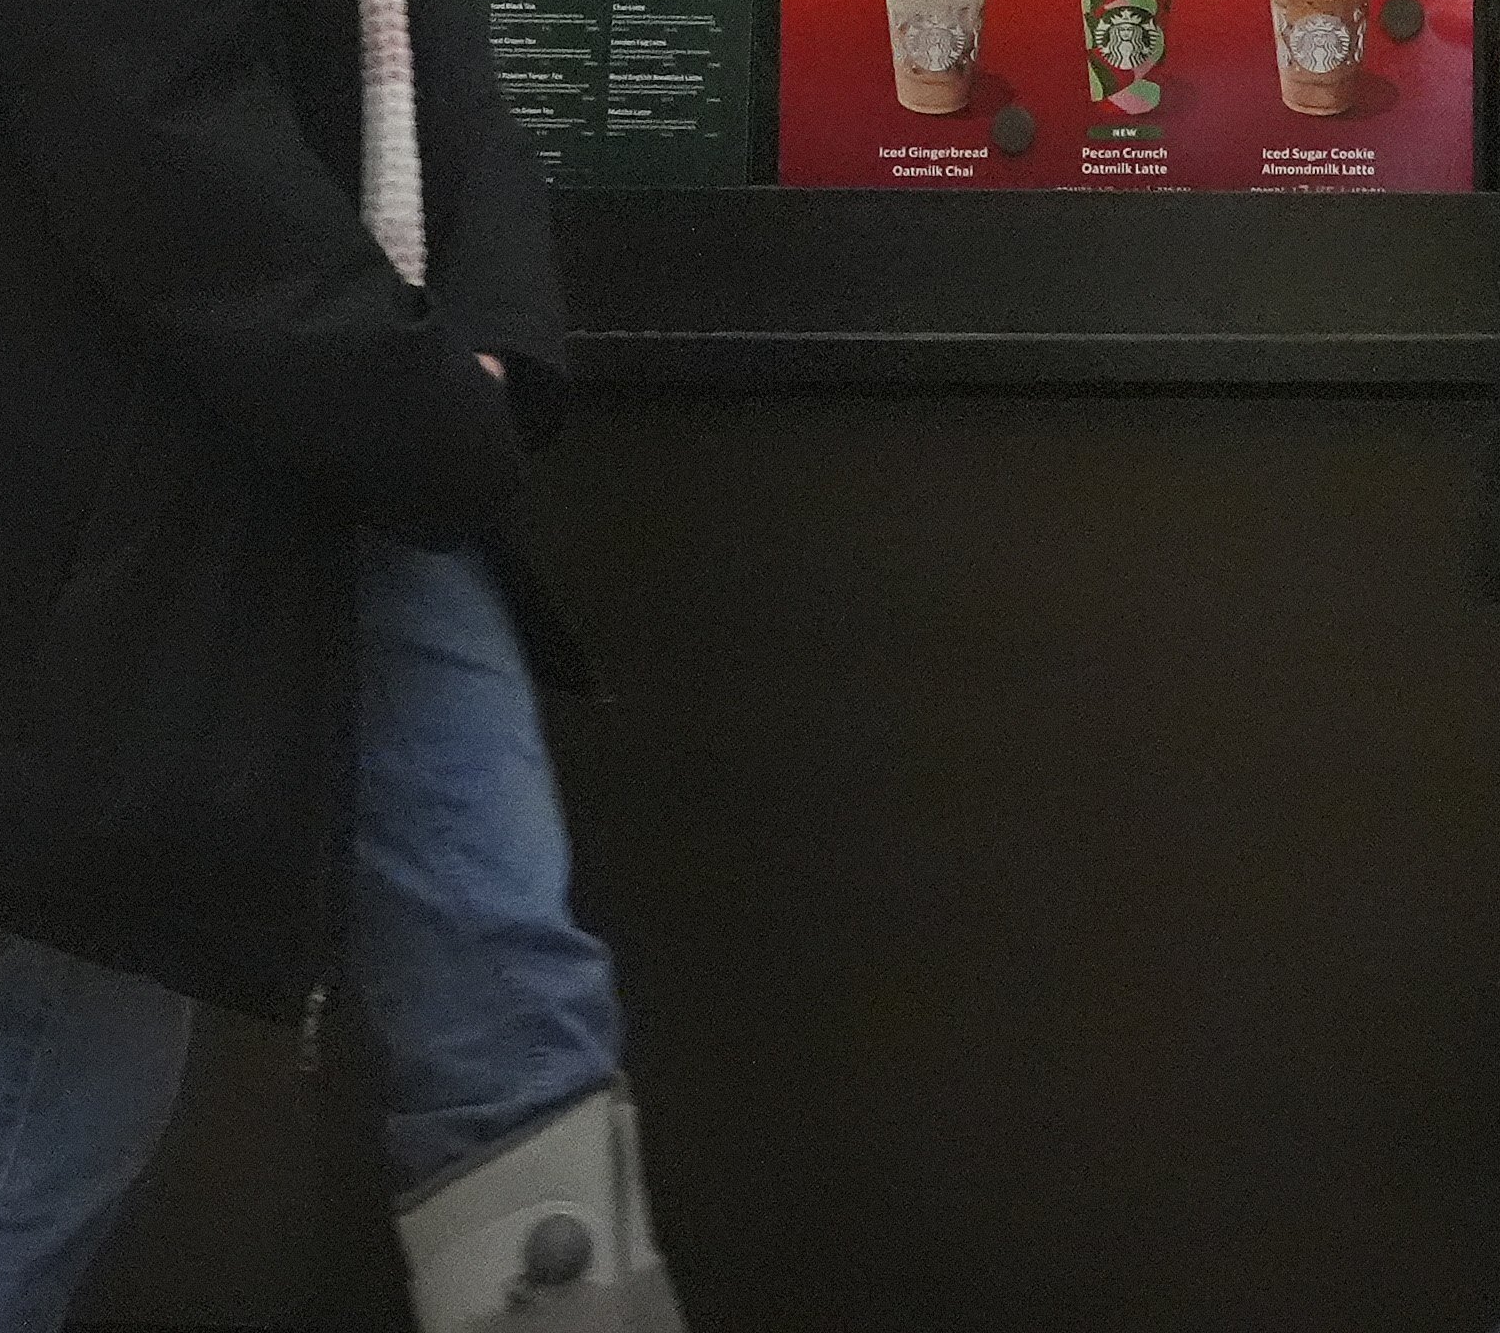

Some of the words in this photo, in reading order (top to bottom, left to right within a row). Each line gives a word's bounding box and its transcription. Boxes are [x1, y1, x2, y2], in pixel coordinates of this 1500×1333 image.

[1112, 128, 1137, 137] NEW
[879, 146, 906, 159] Iced
[908, 146, 988, 161] Gingerbread
[1082, 147, 1118, 160] Pecan
[1122, 146, 1168, 160] Crunch
[1262, 147, 1289, 160] Iced
[1292, 147, 1328, 162] Sugar
[1330, 147, 1375, 160] Cookie
[892, 164, 943, 177] Oatmilk
[945, 164, 974, 178] Chai
[1081, 162, 1132, 175] Oatmilk
[1134, 162, 1168, 175] Latte
[1261, 162, 1339, 175] Almondmilk
[1342, 162, 1375, 175] Latte
